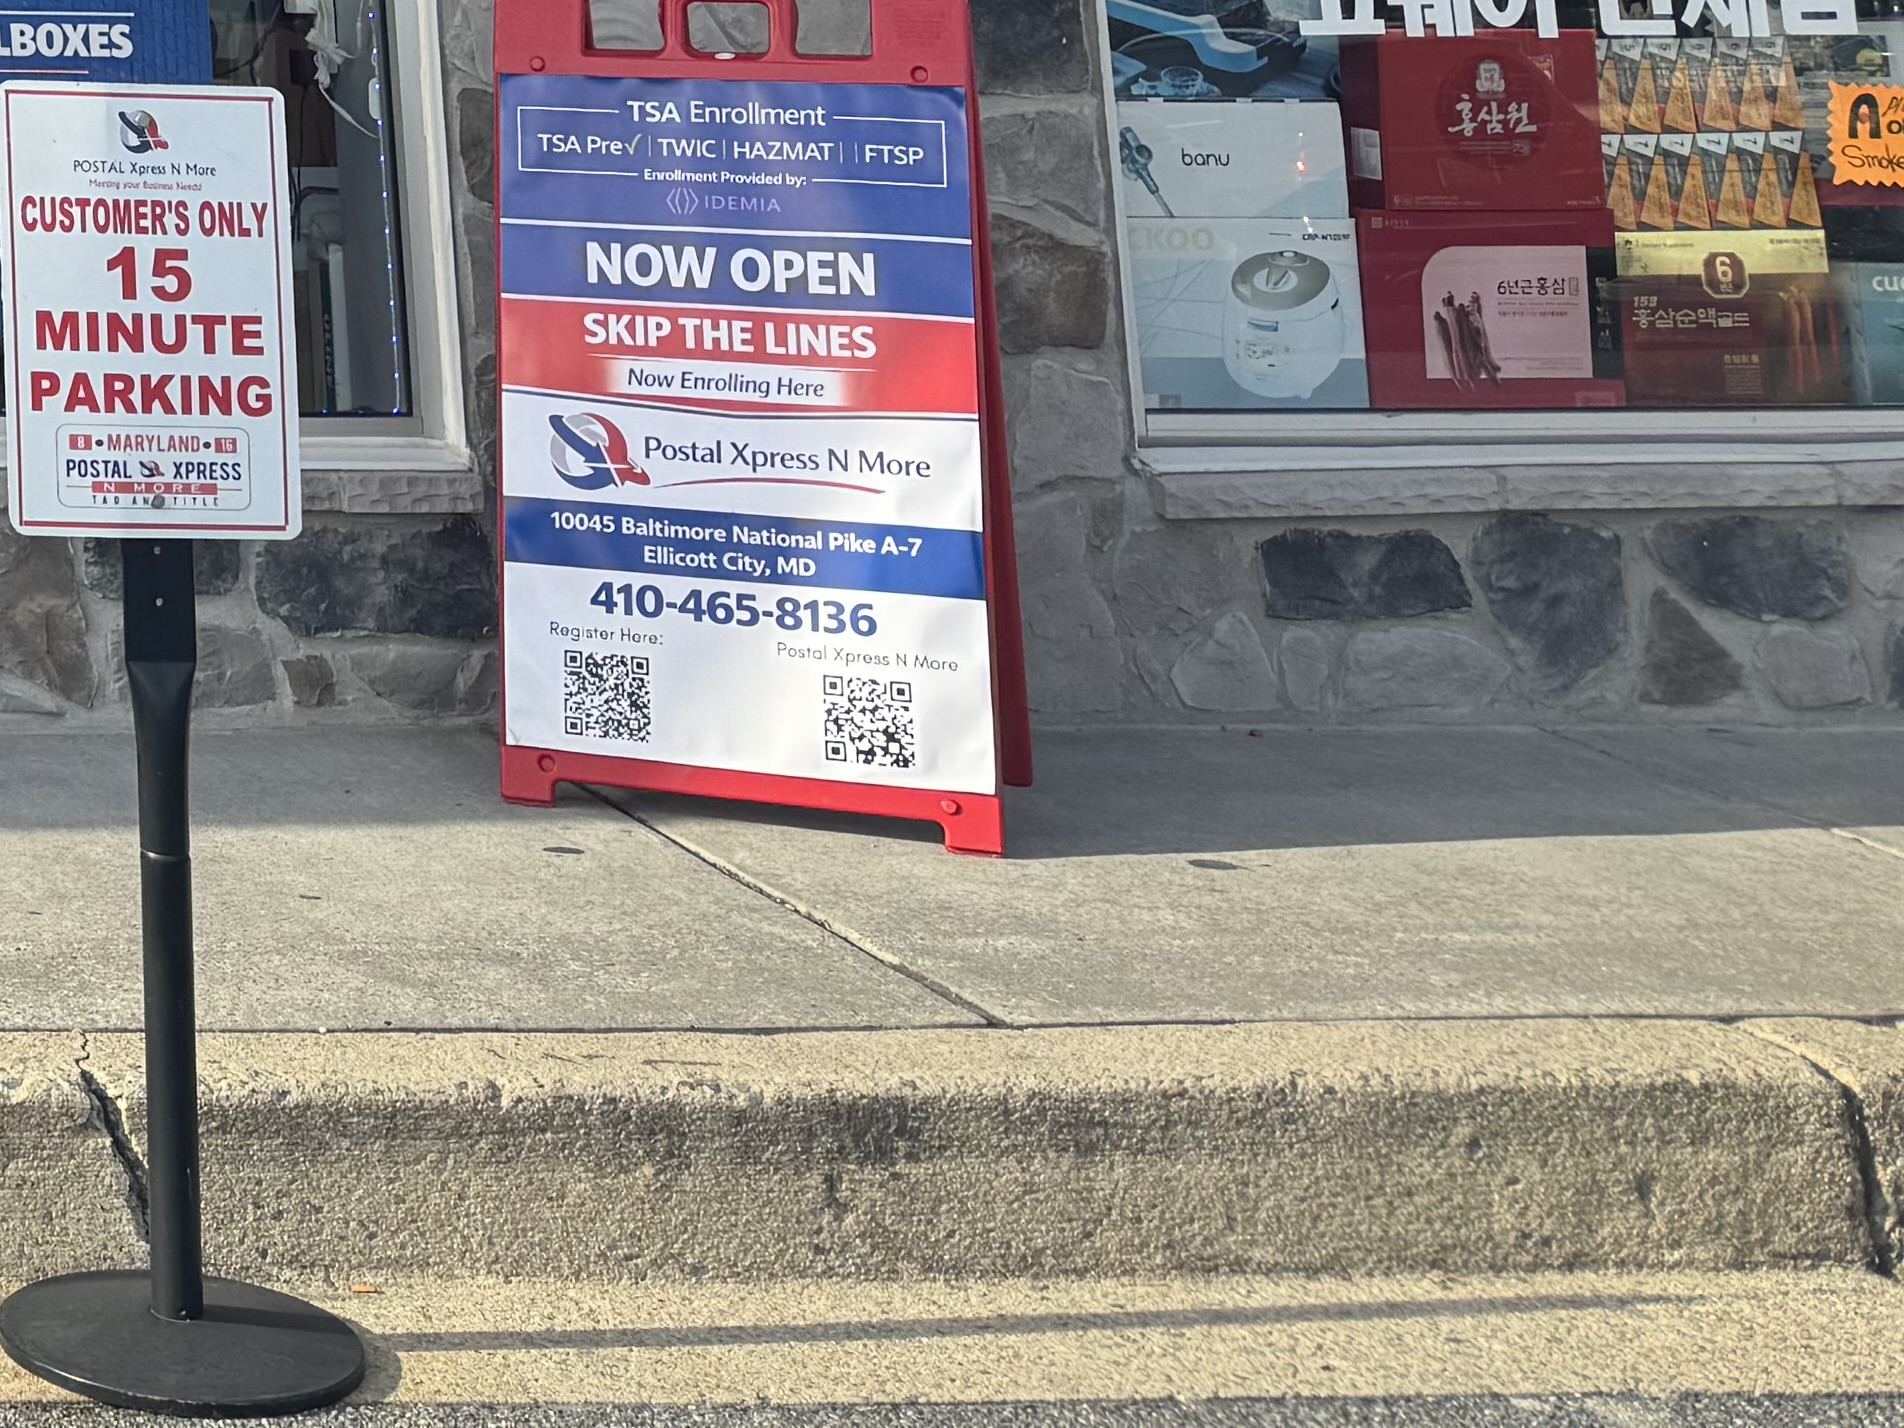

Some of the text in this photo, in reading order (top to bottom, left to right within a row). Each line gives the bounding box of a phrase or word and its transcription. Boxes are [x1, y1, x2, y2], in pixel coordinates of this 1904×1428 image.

[627, 100, 826, 126] TSA Enrollment
[537, 133, 582, 154] TSA
[657, 138, 717, 159] TWIC
[733, 140, 835, 162] HAZMAT
[864, 144, 925, 166] FTSP
[1181, 148, 1230, 167] banu
[21, 195, 268, 238] CUSTOMER'S ONLY
[704, 194, 781, 213] IDEMIA
[106, 246, 192, 303] 15
[585, 240, 876, 297] NOW OPEN
[35, 310, 265, 356] MINUTE
[583, 312, 877, 360] SKIP THE LINES
[30, 371, 273, 417] PARKING
[627, 367, 825, 400] Now Enrolling Here
[107, 434, 201, 453] MARYLAND
[643, 435, 931, 479] Postal Xpress N More
[66, 460, 242, 481] POSTAL XPRESS
[550, 511, 923, 558] 10045 Baltimore National Pike A-7
[643, 544, 816, 577] Ellicott City, MD
[590, 581, 878, 637] 410-465-8136
